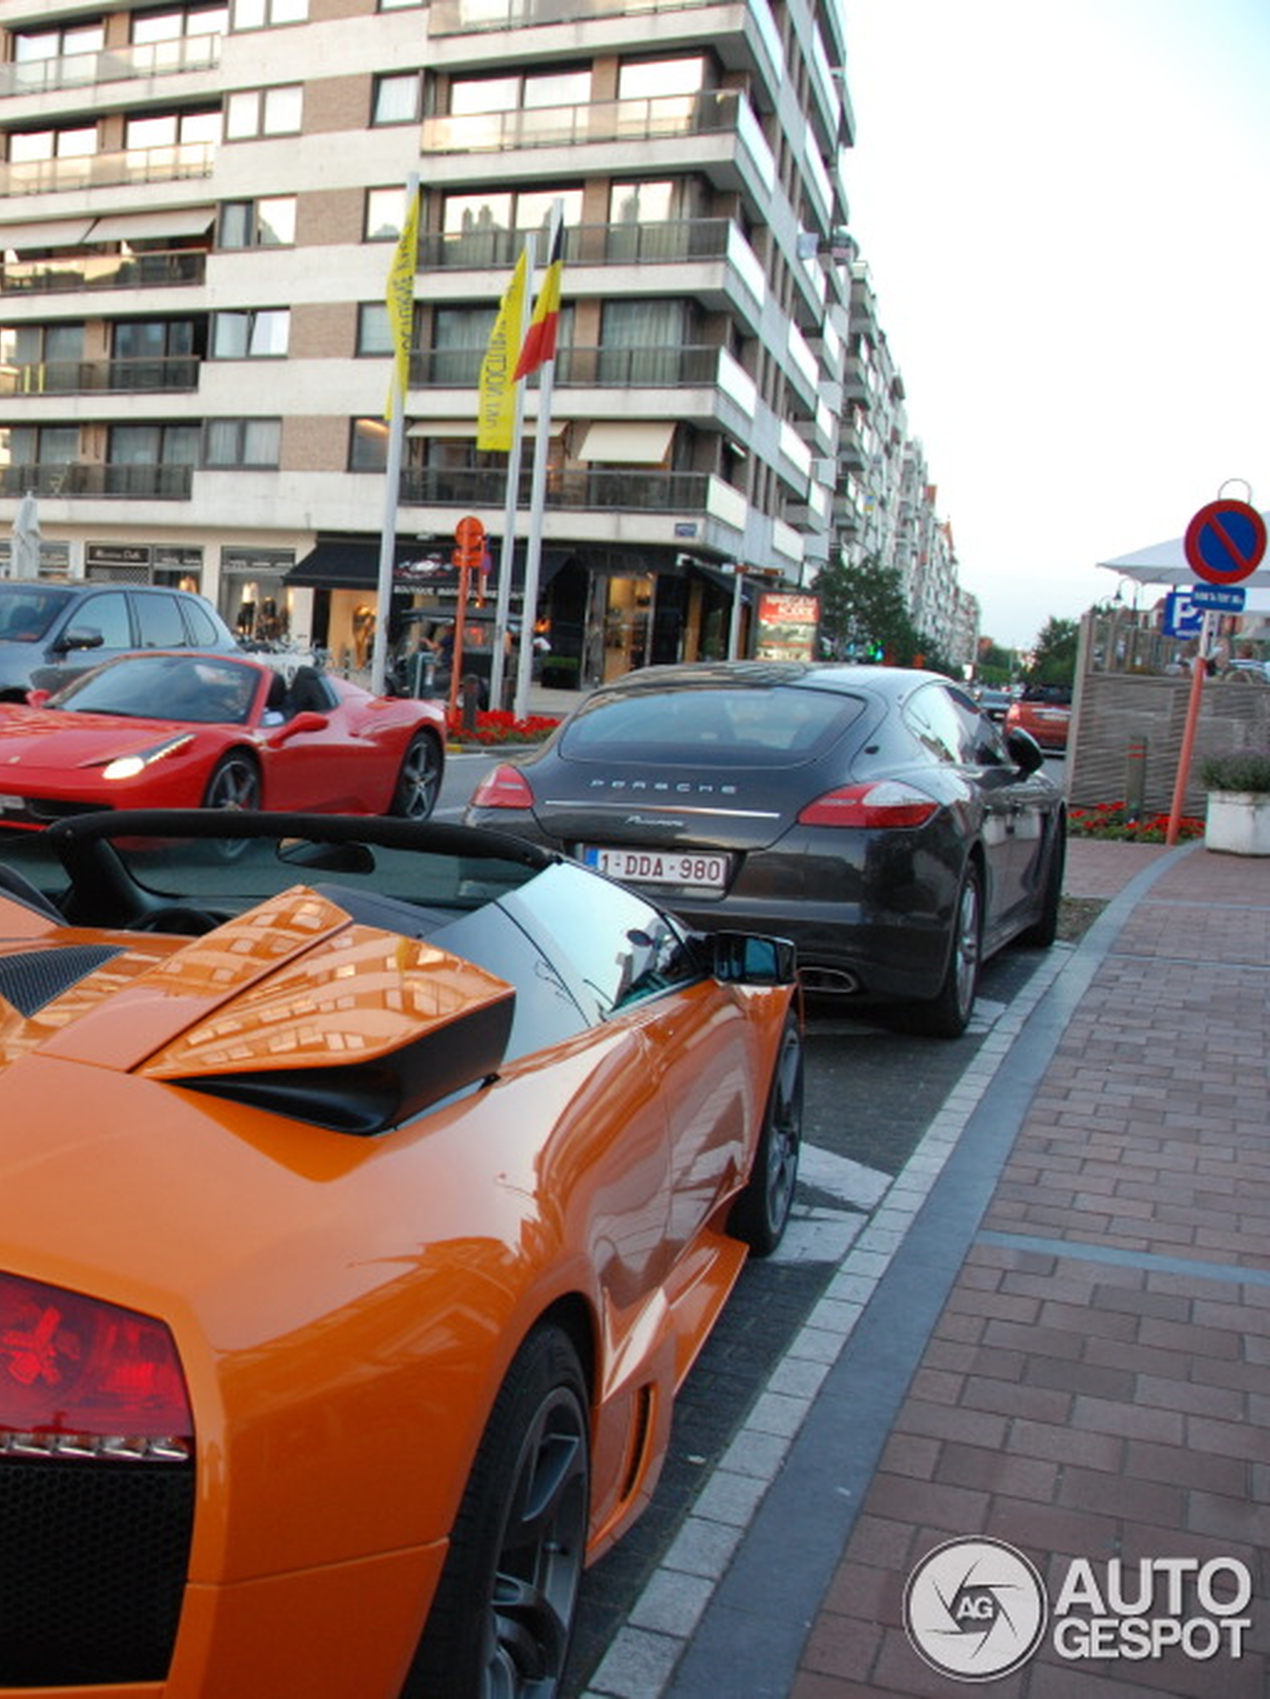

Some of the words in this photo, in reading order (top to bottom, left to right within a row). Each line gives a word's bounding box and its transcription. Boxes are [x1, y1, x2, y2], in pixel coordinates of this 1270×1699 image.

[1173, 597, 1198, 628] P
[590, 779, 736, 794] PORSCHE
[600, 853, 721, 882] 1-DDA-980
